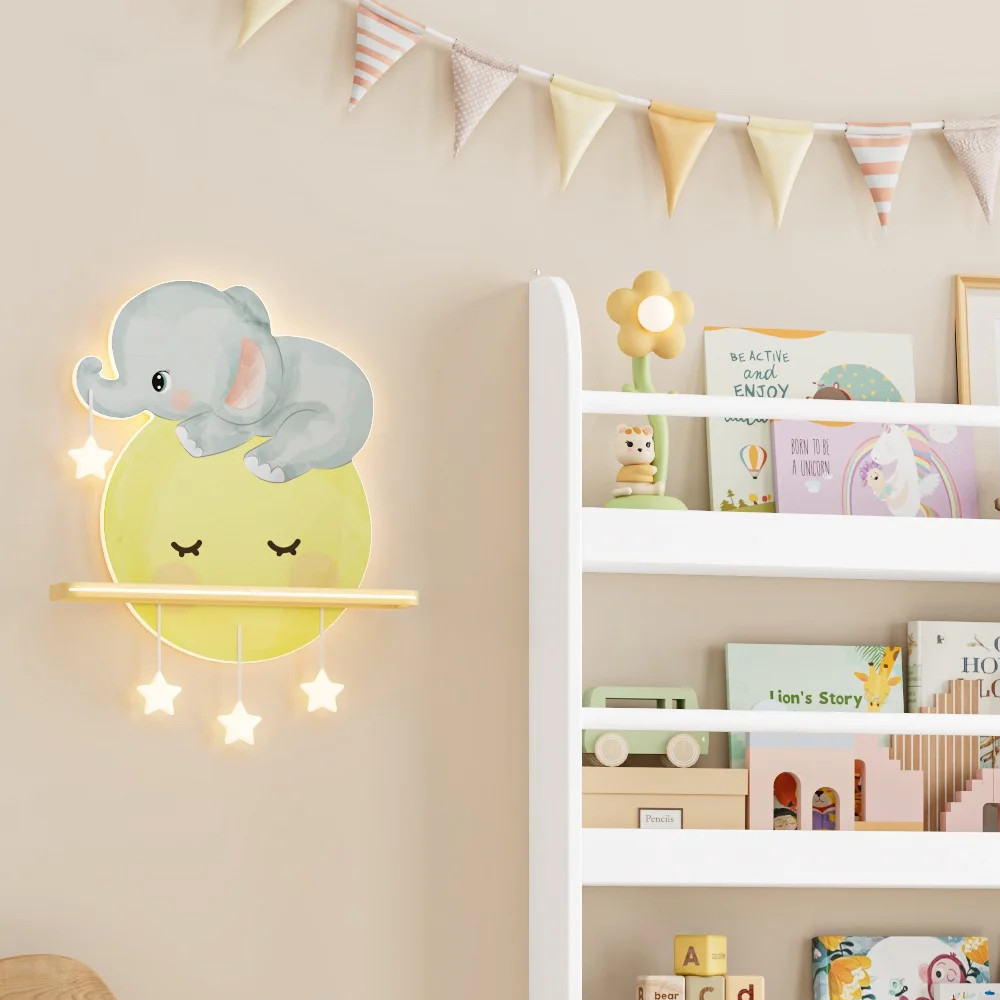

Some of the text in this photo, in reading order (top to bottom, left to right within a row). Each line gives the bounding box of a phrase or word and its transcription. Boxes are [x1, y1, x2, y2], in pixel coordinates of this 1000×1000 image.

[730, 349, 790, 362] BE ACTIVE
[743, 363, 778, 380] and
[733, 383, 789, 398] ENJOY
[791, 438, 831, 456] BORN TO BE
[792, 460, 831, 477] A UNICORN
[818, 690, 863, 709] Story
[645, 813, 675, 824] Pencils
[682, 945, 700, 966] A
[654, 991, 680, 1000] bear
